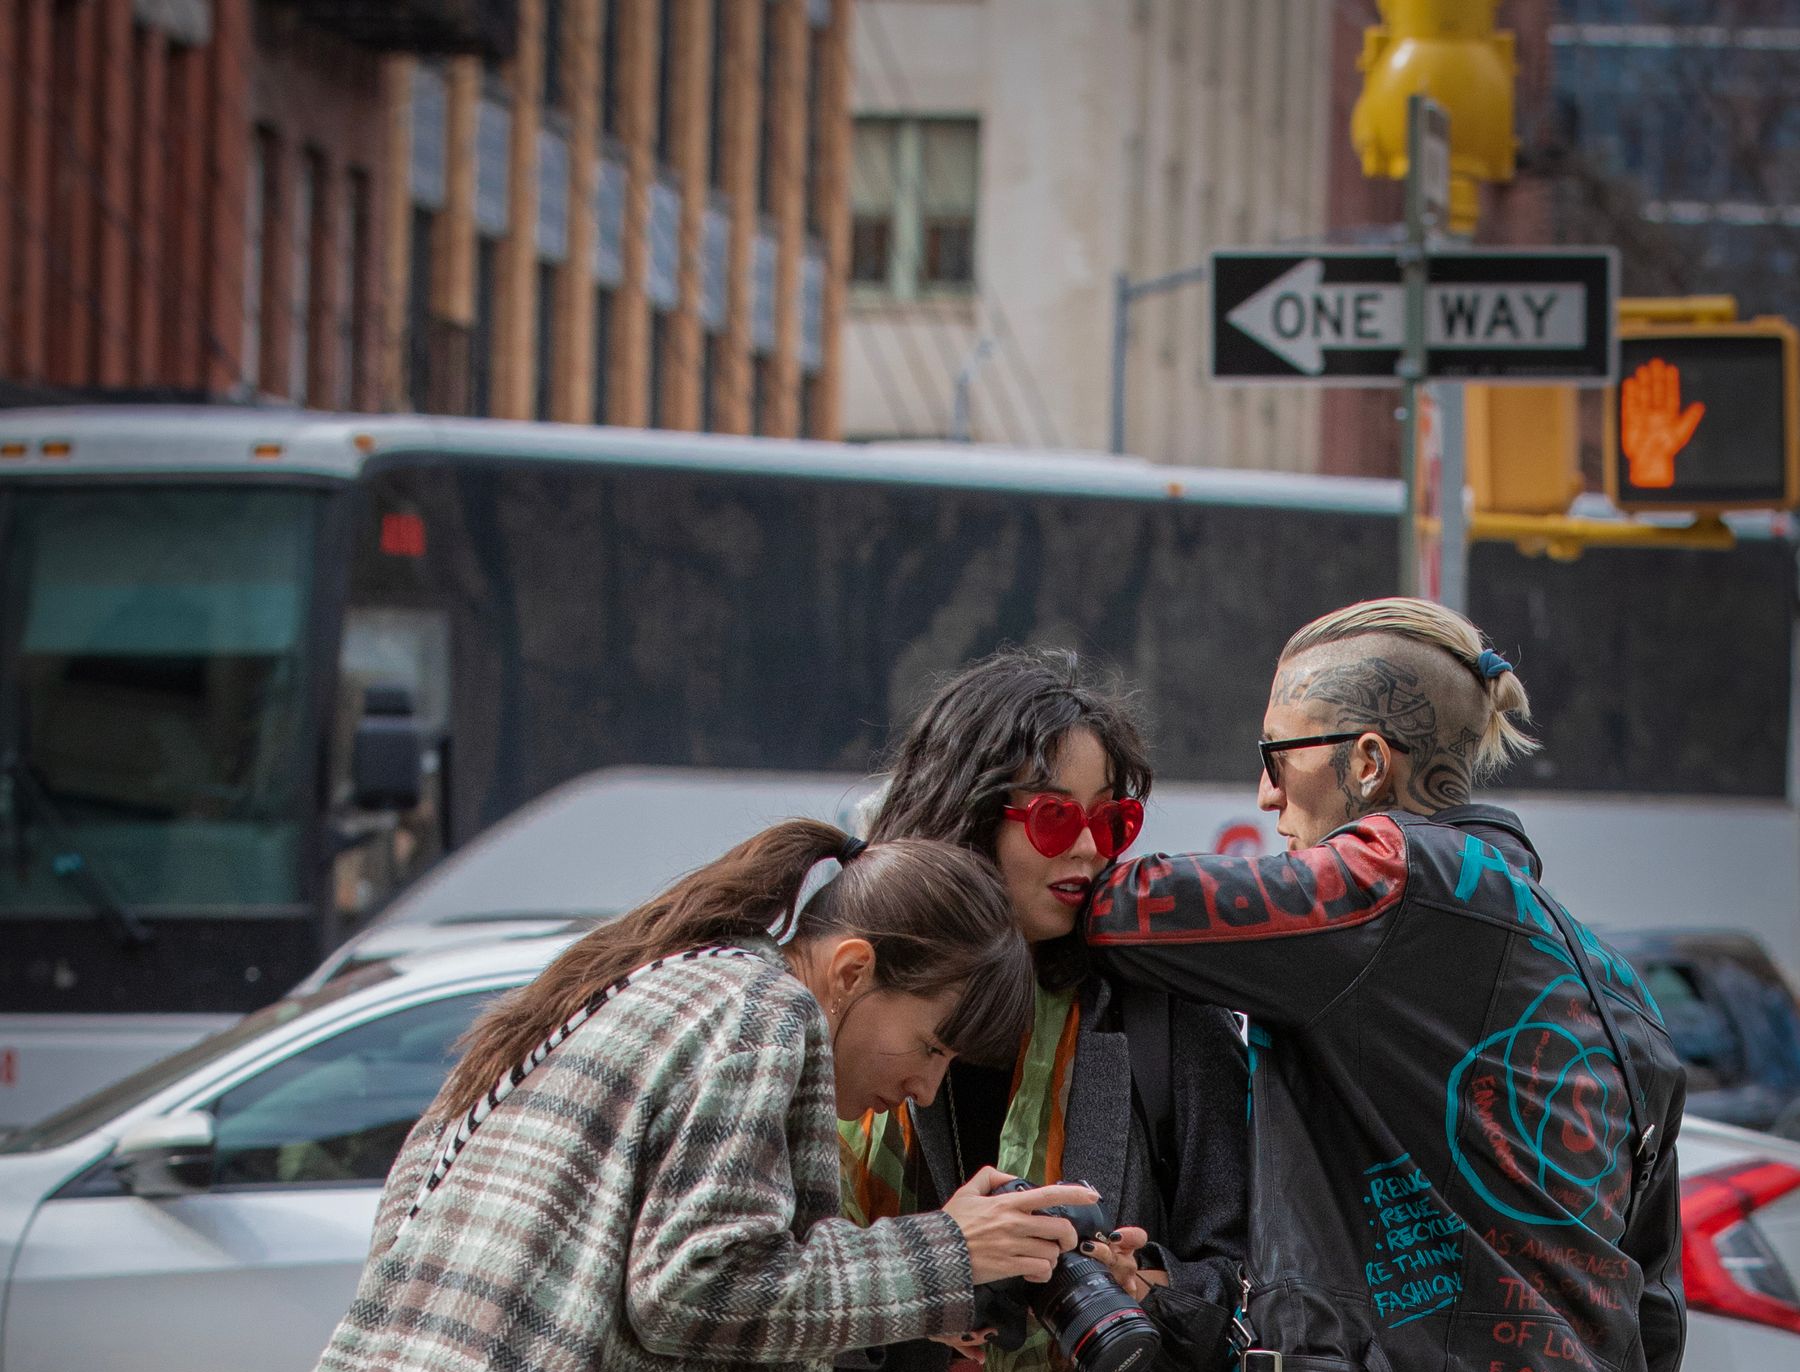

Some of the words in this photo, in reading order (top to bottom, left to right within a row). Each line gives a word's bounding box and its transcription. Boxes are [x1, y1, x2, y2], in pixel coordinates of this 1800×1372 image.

[1271, 294, 1385, 341] ONE
[1437, 294, 1559, 340] WAY
[1562, 1075, 1596, 1152] S
[1365, 1261, 1394, 1287] RE
[1373, 1271, 1464, 1319] FASHION
[1492, 1320, 1537, 1350] OF
